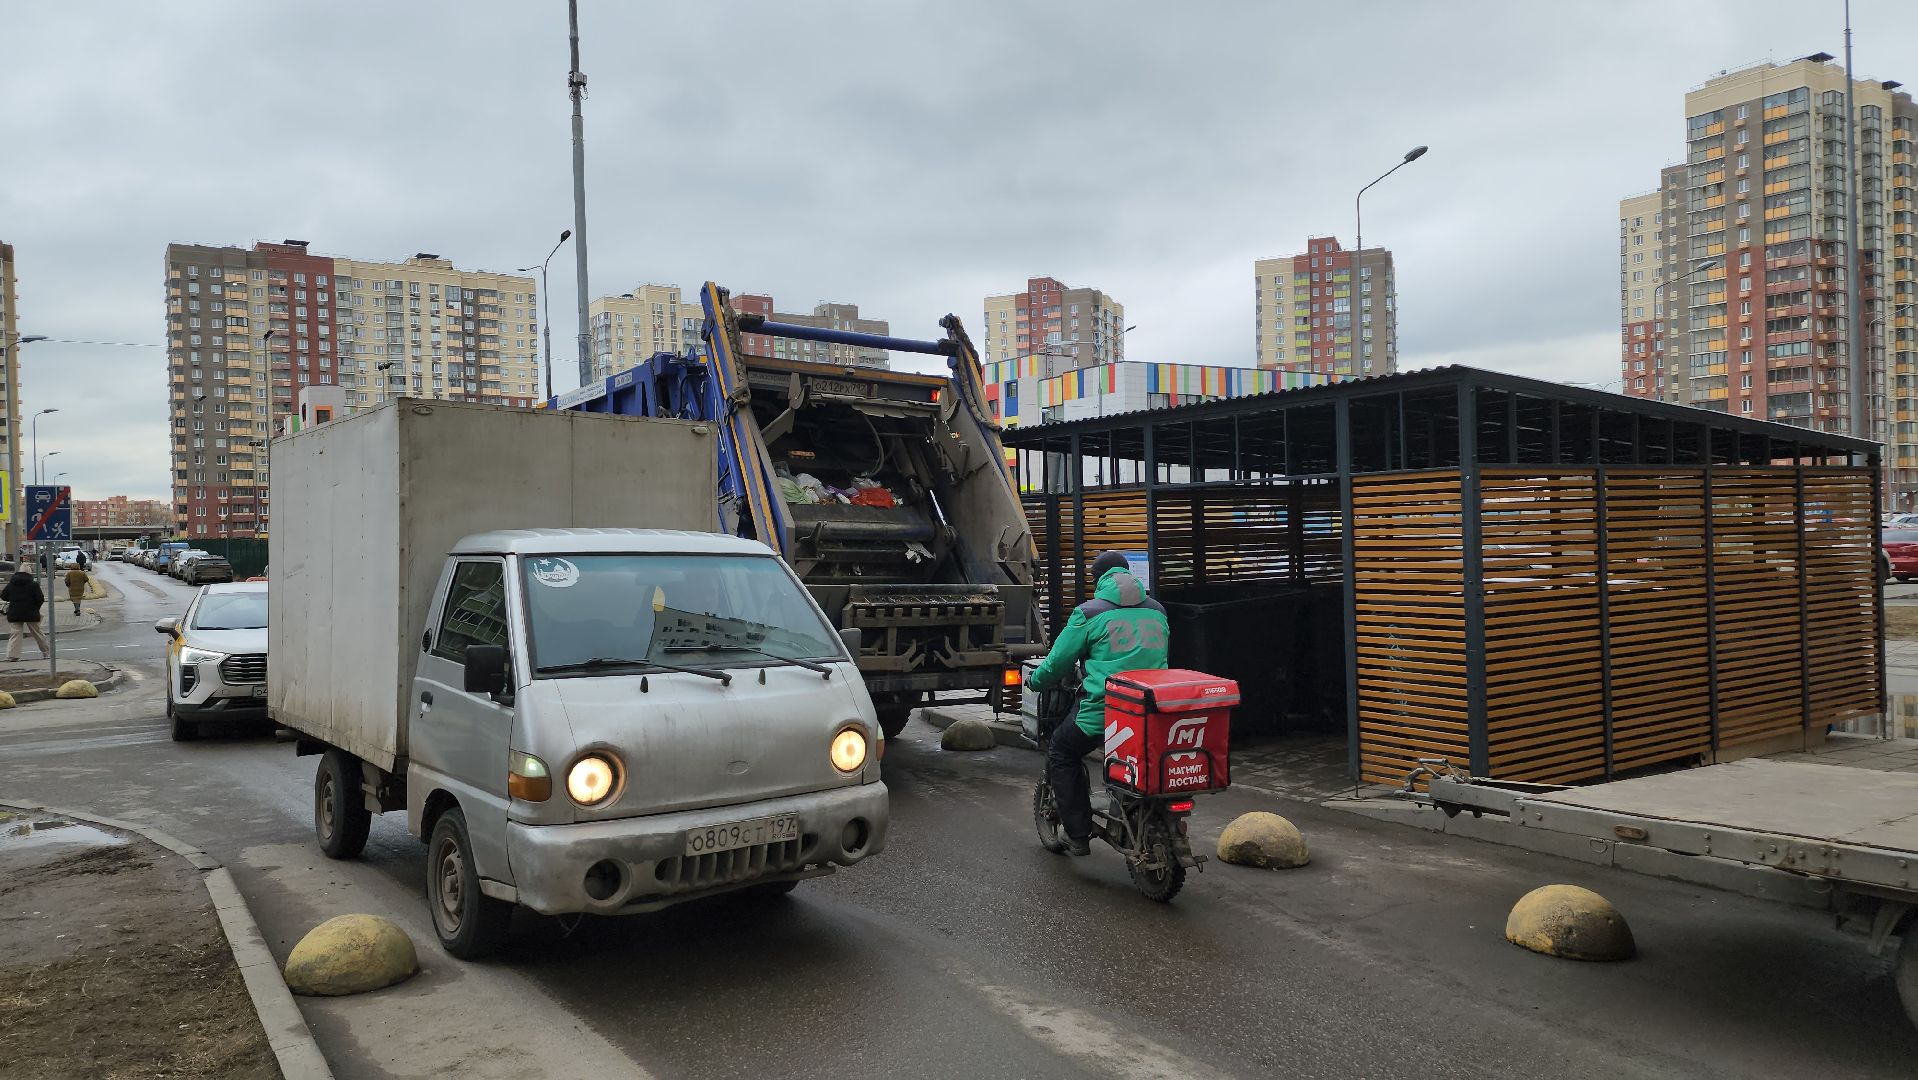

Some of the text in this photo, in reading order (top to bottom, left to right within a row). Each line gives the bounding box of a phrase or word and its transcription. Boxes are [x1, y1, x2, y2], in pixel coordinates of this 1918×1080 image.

[1168, 764, 1203, 775] МАГНИТ
[1168, 774, 1208, 788] ДОСТАВК
[692, 817, 794, 851] О809СТ 197
